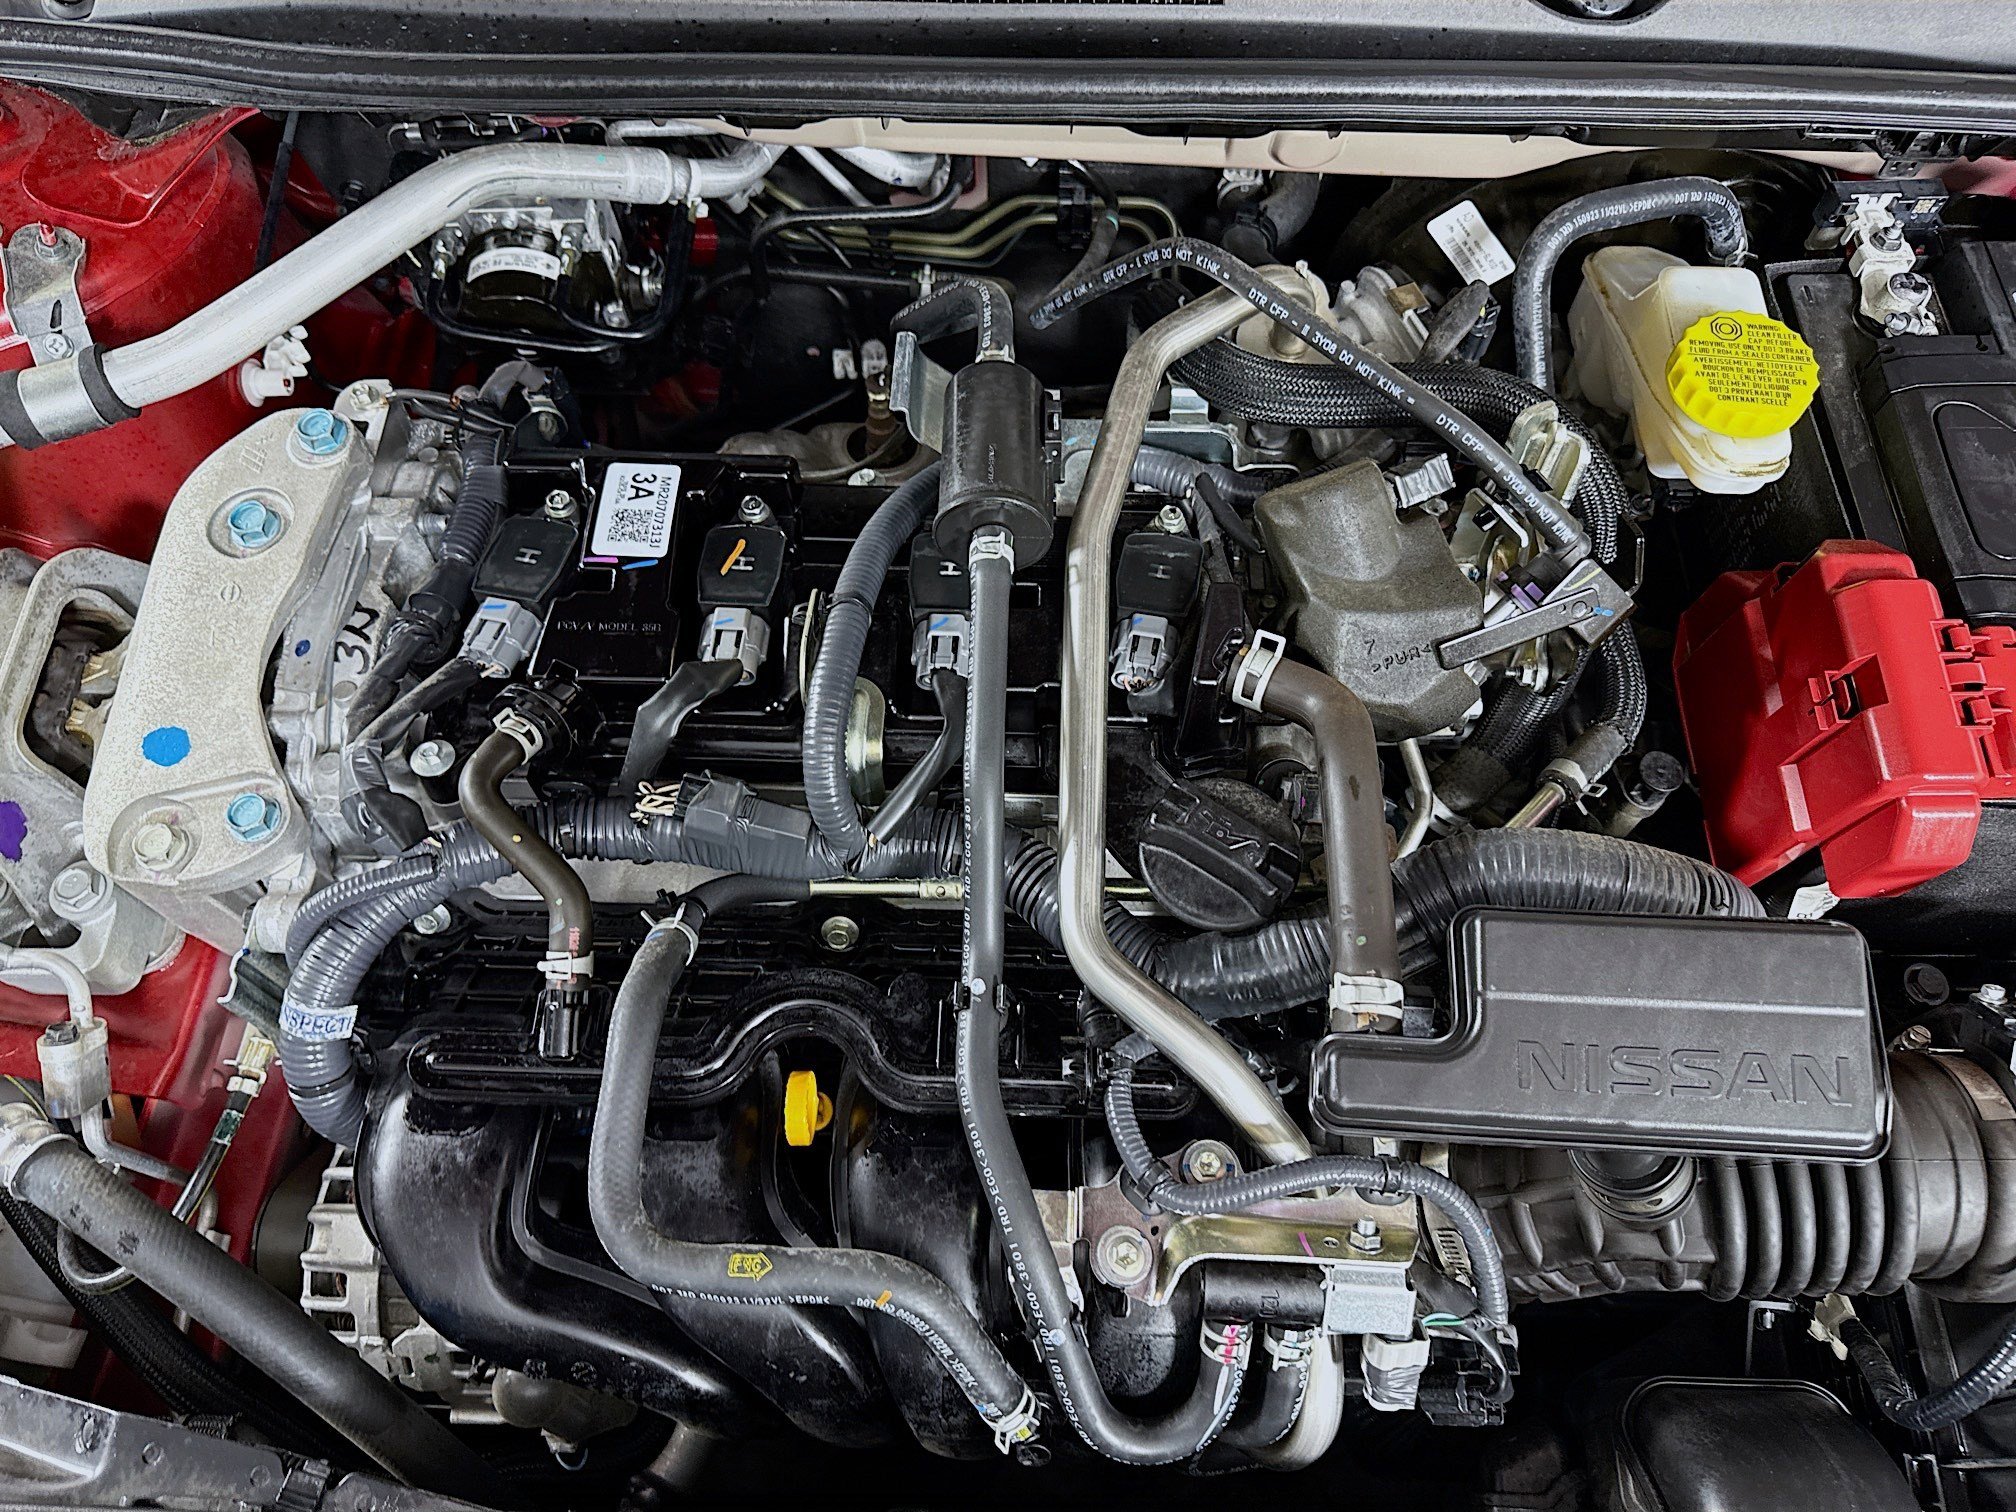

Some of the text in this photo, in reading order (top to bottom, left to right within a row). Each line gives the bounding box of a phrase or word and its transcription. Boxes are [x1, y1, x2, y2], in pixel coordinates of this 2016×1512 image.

[1747, 323, 1781, 332] WARNING:
[1747, 331, 1797, 341] CLEAN FILLER
[1689, 346, 1710, 354] FLUID
[1741, 351, 1771, 359] SEALED
[1743, 344, 1761, 352] ONLY
[1785, 347, 1809, 355] BRAKE
[1702, 364, 1735, 373] BOUCHON
[1747, 368, 1797, 378] REMPLISSAGE
[1757, 362, 1794, 371] NETTOYER
[1795, 364, 1804, 372] LE
[1695, 370, 1719, 379] AVANT
[1776, 377, 1808, 386] UTILISER
[1708, 379, 1750, 388] SEULEMENT
[1175, 248, 1193, 262] NOT
[1196, 255, 1221, 275] KINK
[1248, 288, 1268, 308] DTR
[1269, 302, 1289, 320] CFP
[1338, 349, 1354, 366] DO
[1355, 361, 1377, 381] NOT
[1377, 375, 1406, 400] KINK
[1435, 413, 1461, 436] DTR
[1461, 432, 1485, 452] CFP
[1536, 506, 1558, 524] NOT
[1731, 388, 1773, 397] PROVENANT
[1717, 394, 1759, 404] CONTENANT
[627, 472, 658, 501] 3A
[598, 621, 637, 632] MODEL
[1517, 1039, 1852, 1107] NISSAN
